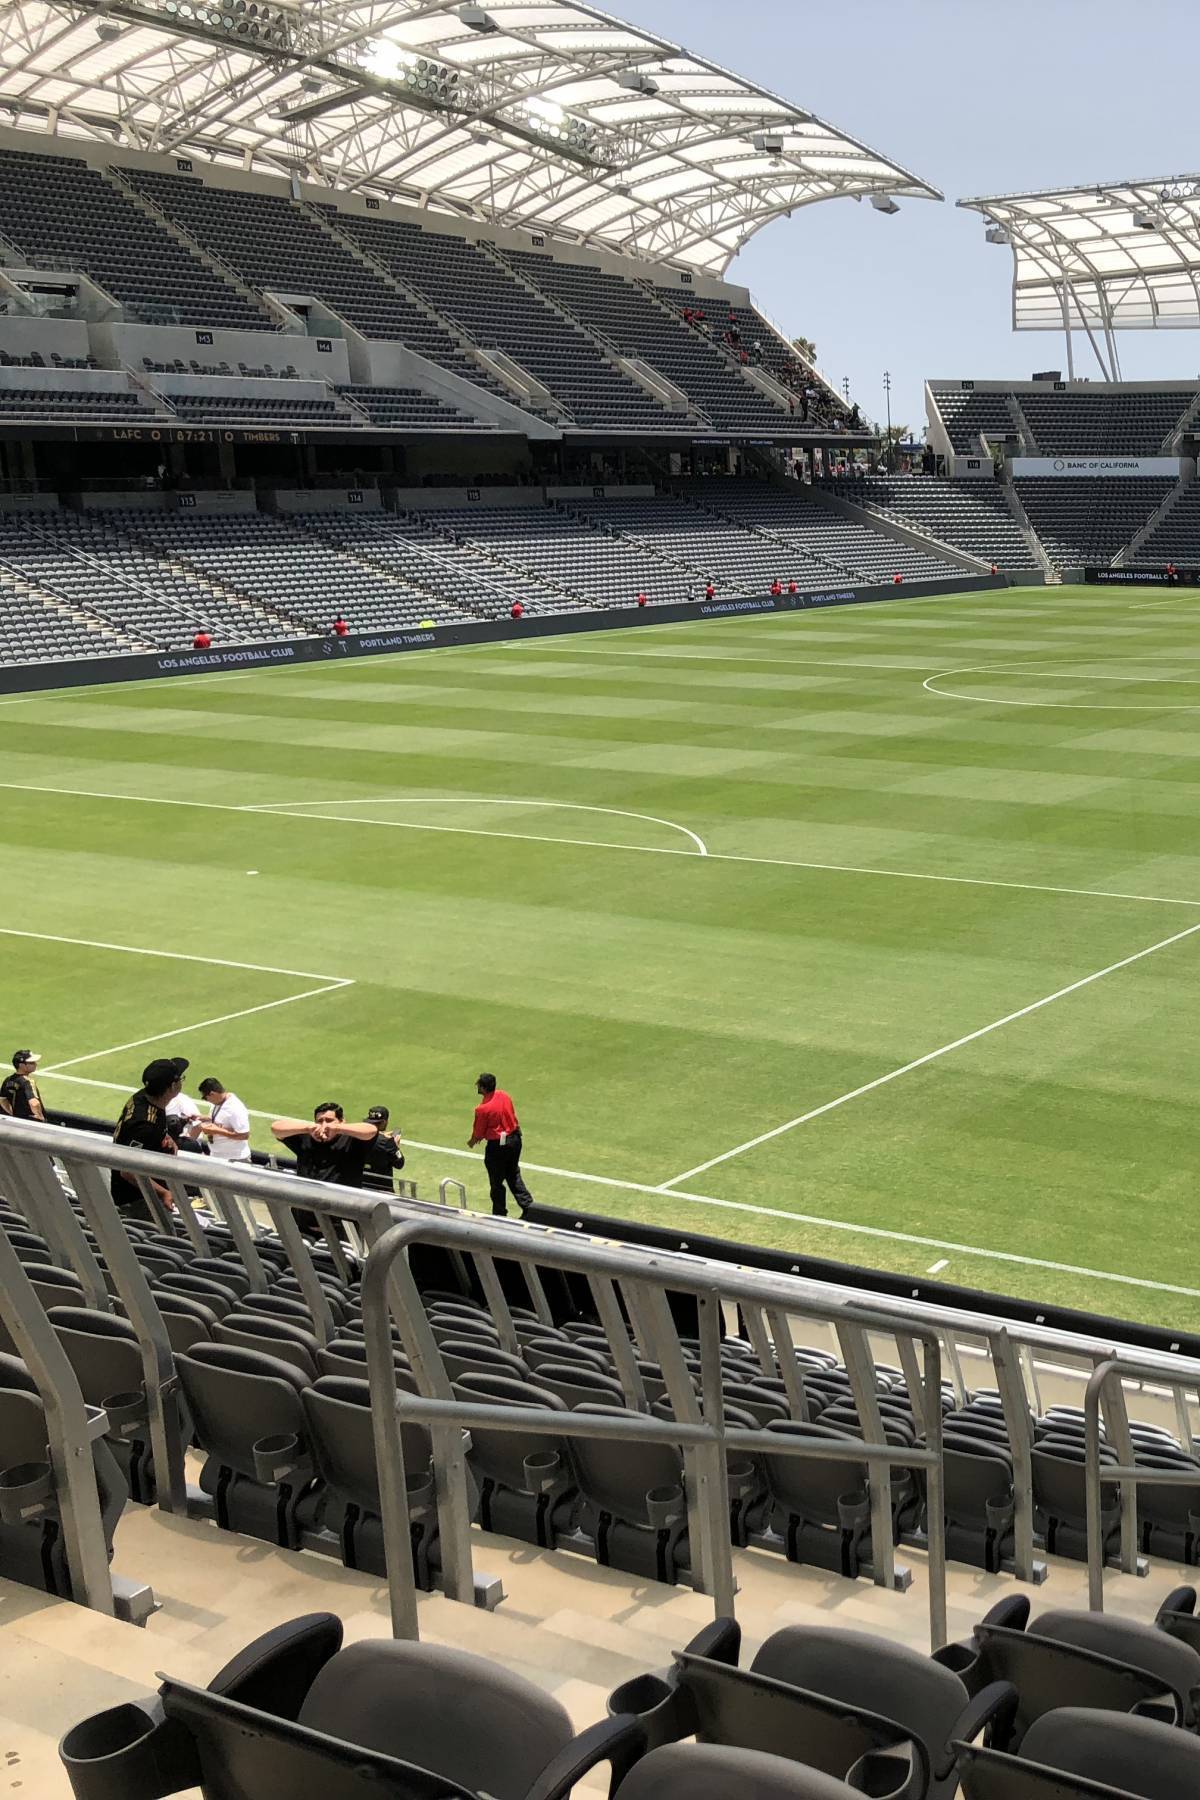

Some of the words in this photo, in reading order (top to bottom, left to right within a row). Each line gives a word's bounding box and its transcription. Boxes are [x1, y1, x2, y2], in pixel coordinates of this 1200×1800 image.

[179, 161, 191, 170] 214
[198, 335, 211, 343] M3
[113, 430, 143, 440] LAFC
[177, 431, 214, 441] 87:21
[243, 432, 281, 442] TIMBERS
[181, 496, 194, 506] 113
[350, 494, 362, 502] 114
[735, 601, 761, 610] FOOTBALL
[360, 636, 402, 648] PORTLAND
[402, 633, 436, 643] TIMBERS
[158, 658, 179, 669] LOS
[179, 654, 222, 666] ANGELES
[223, 650, 270, 662] FOOTBALL
[270, 647, 294, 658] CLUB
